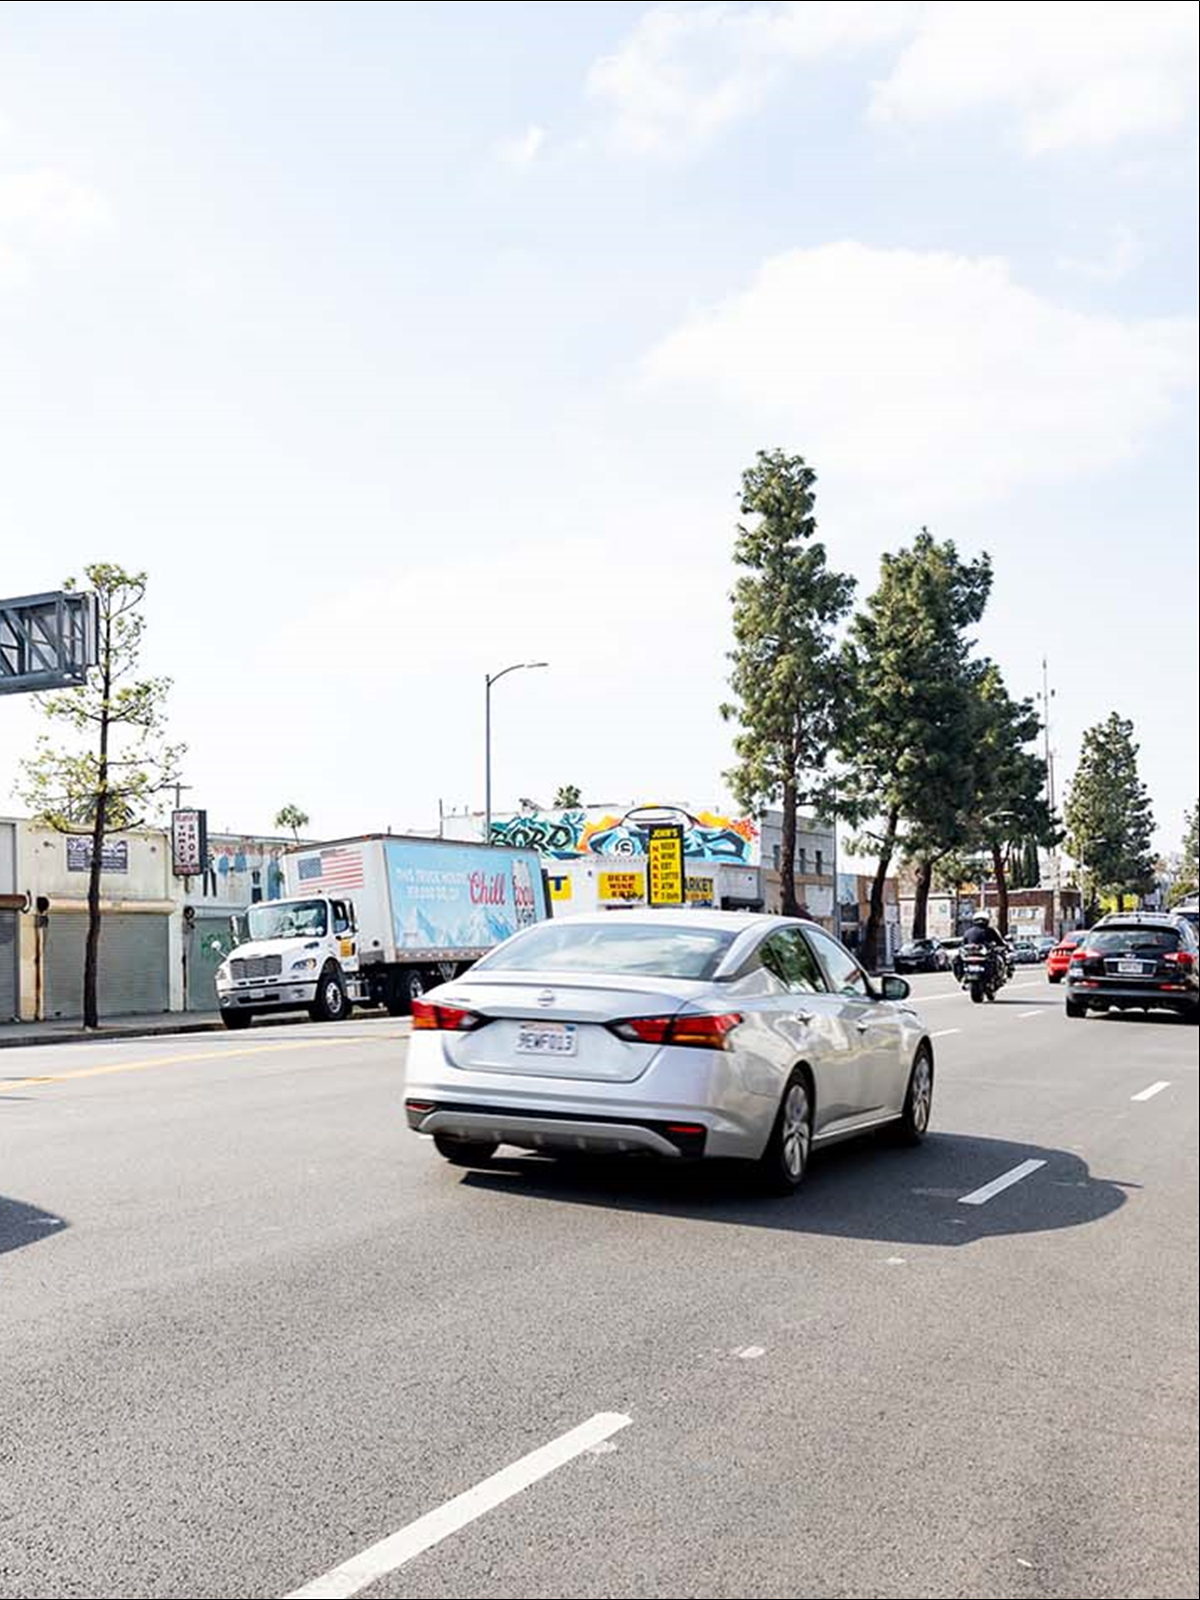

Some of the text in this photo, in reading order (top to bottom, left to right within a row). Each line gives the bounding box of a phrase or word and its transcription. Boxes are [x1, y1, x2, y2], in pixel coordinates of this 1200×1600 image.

[188, 824, 196, 861] SHOP
[470, 870, 506, 906] Chill
[608, 882, 635, 890] WINE
[686, 876, 713, 893] ARKET
